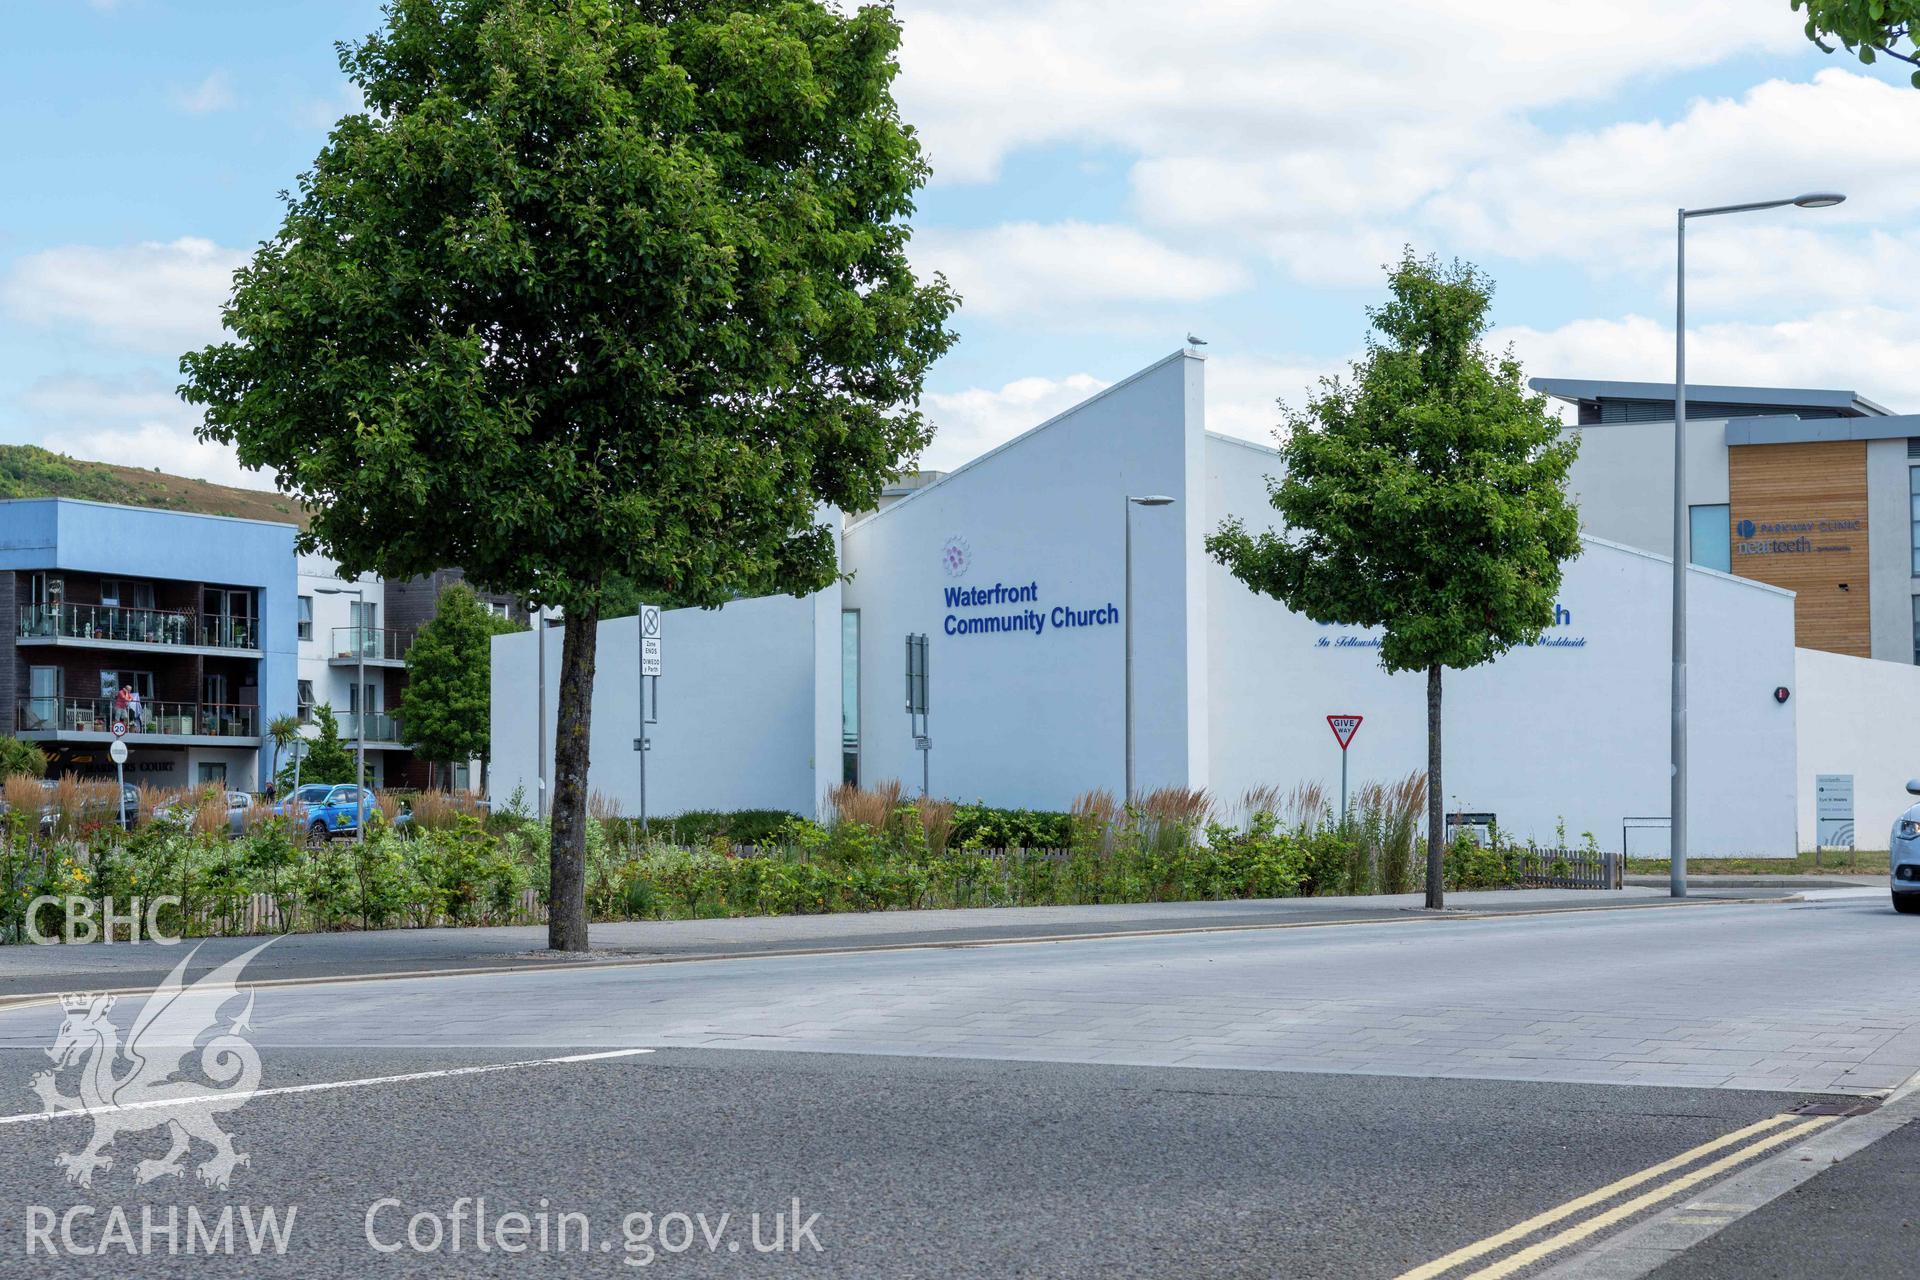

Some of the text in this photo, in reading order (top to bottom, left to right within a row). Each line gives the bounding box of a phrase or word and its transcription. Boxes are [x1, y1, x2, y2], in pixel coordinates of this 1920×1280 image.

[1761, 519, 1861, 533] PARKWAY CLINIC
[944, 581, 1038, 607] Waterfront
[944, 603, 1119, 635] Community Church
[1314, 636, 1330, 648] In
[1539, 635, 1587, 647] Worldwide
[114, 725, 125, 733] 20
[86, 761, 175, 773] MARINRS COURT
